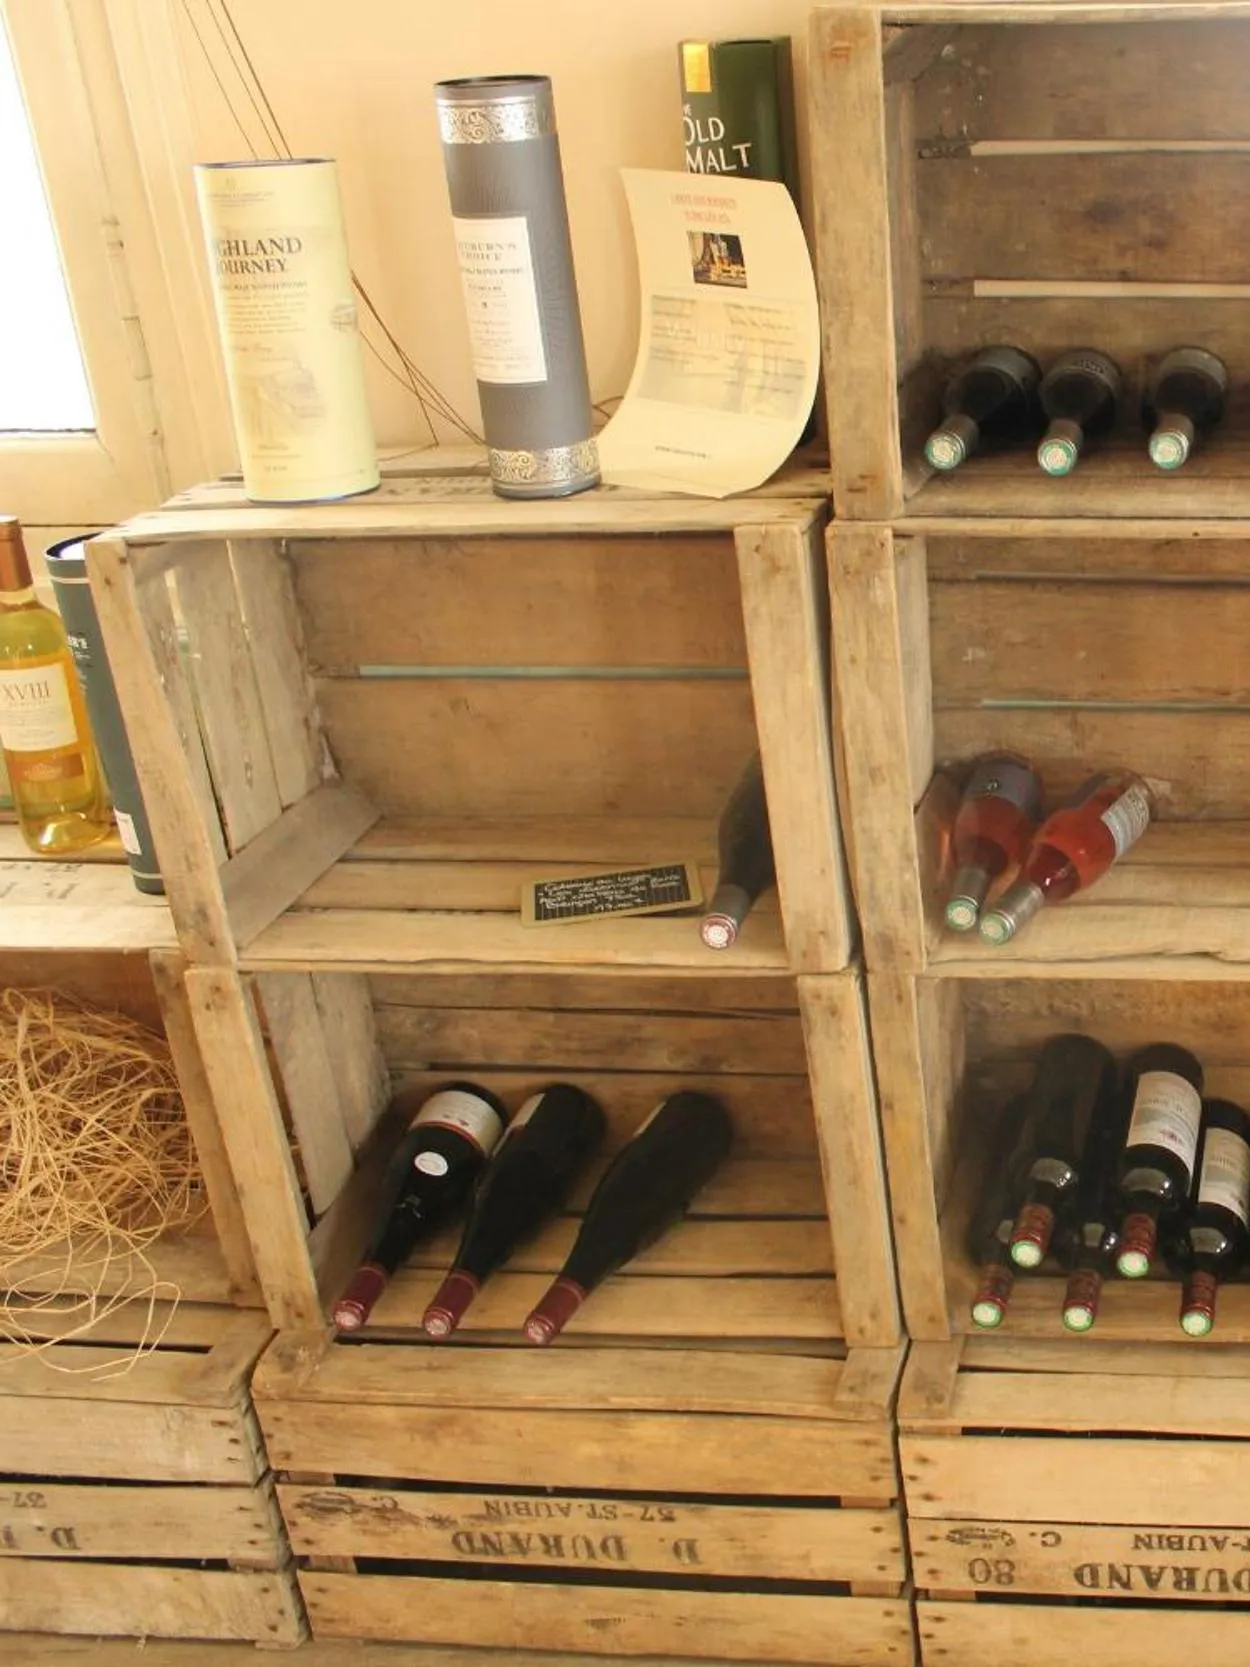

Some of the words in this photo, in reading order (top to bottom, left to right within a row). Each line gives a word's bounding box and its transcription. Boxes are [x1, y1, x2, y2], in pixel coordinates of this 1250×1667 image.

[683, 116, 725, 147] OLD
[685, 142, 752, 175] MALT
[451, 1530, 628, 1562] DURAND
[968, 1557, 1015, 1586] 80
